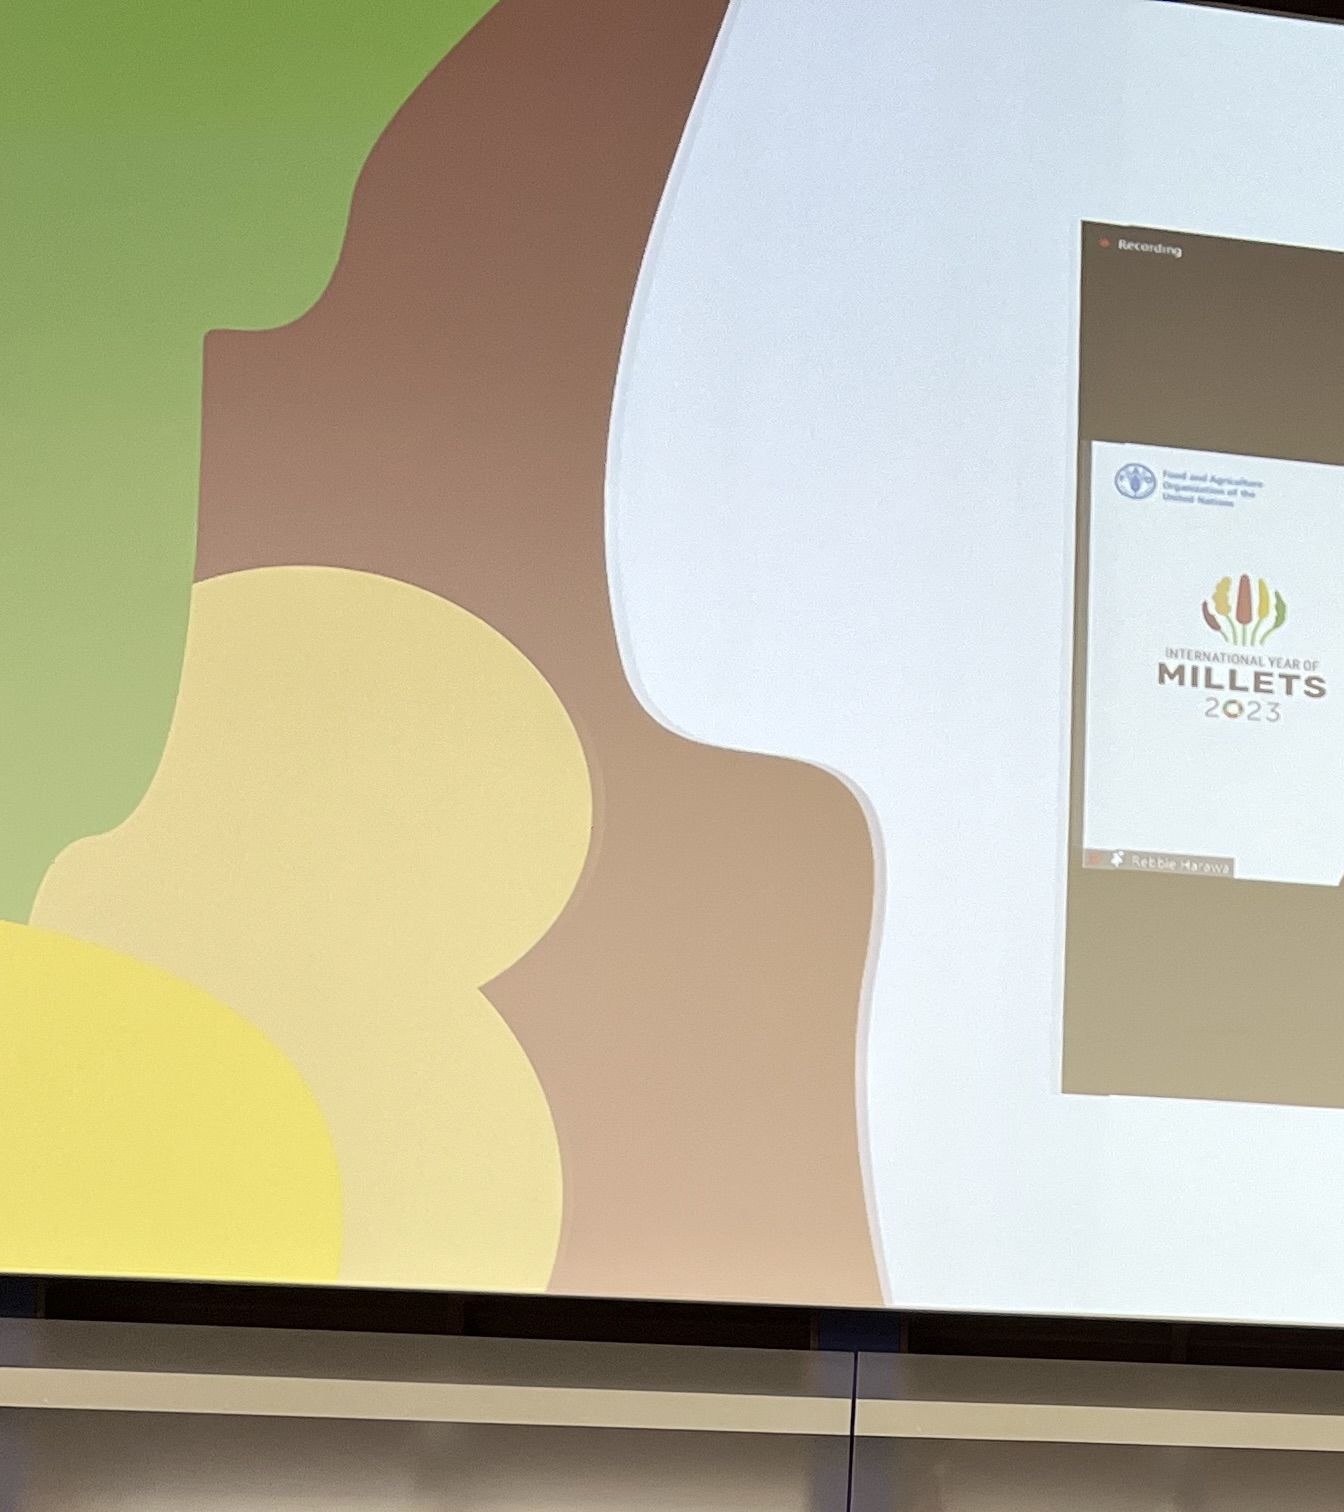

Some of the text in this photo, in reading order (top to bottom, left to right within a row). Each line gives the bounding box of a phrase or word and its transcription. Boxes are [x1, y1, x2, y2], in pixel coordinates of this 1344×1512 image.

[1117, 239, 1183, 258] Recording
[1165, 646, 1320, 672] INTERNATIONAL YEAR OF
[1157, 661, 1327, 699] MILLETS
[1204, 696, 1281, 723] 2023
